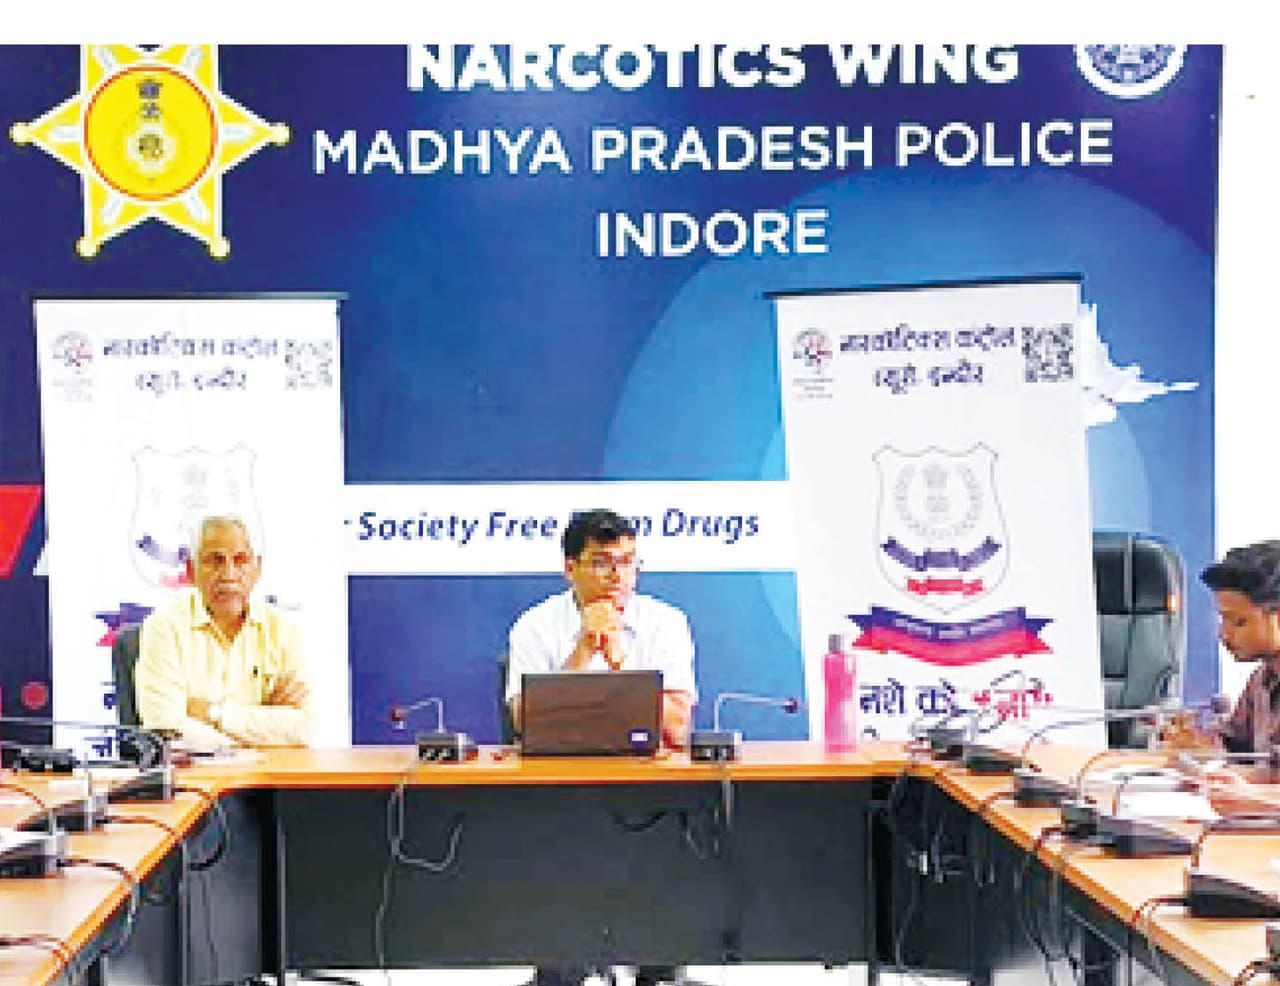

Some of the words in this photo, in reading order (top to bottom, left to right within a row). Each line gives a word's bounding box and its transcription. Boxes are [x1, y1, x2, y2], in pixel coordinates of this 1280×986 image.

[408, 44, 806, 90] NARCOTICS
[828, 44, 1018, 85] WING
[316, 129, 571, 174] MADHYA
[592, 126, 873, 171] PRADESH
[898, 122, 1113, 167] POLICE
[599, 210, 828, 257] INDORE
[357, 511, 479, 546] Society
[485, 511, 558, 538] Free
[662, 508, 760, 544] Drugs
